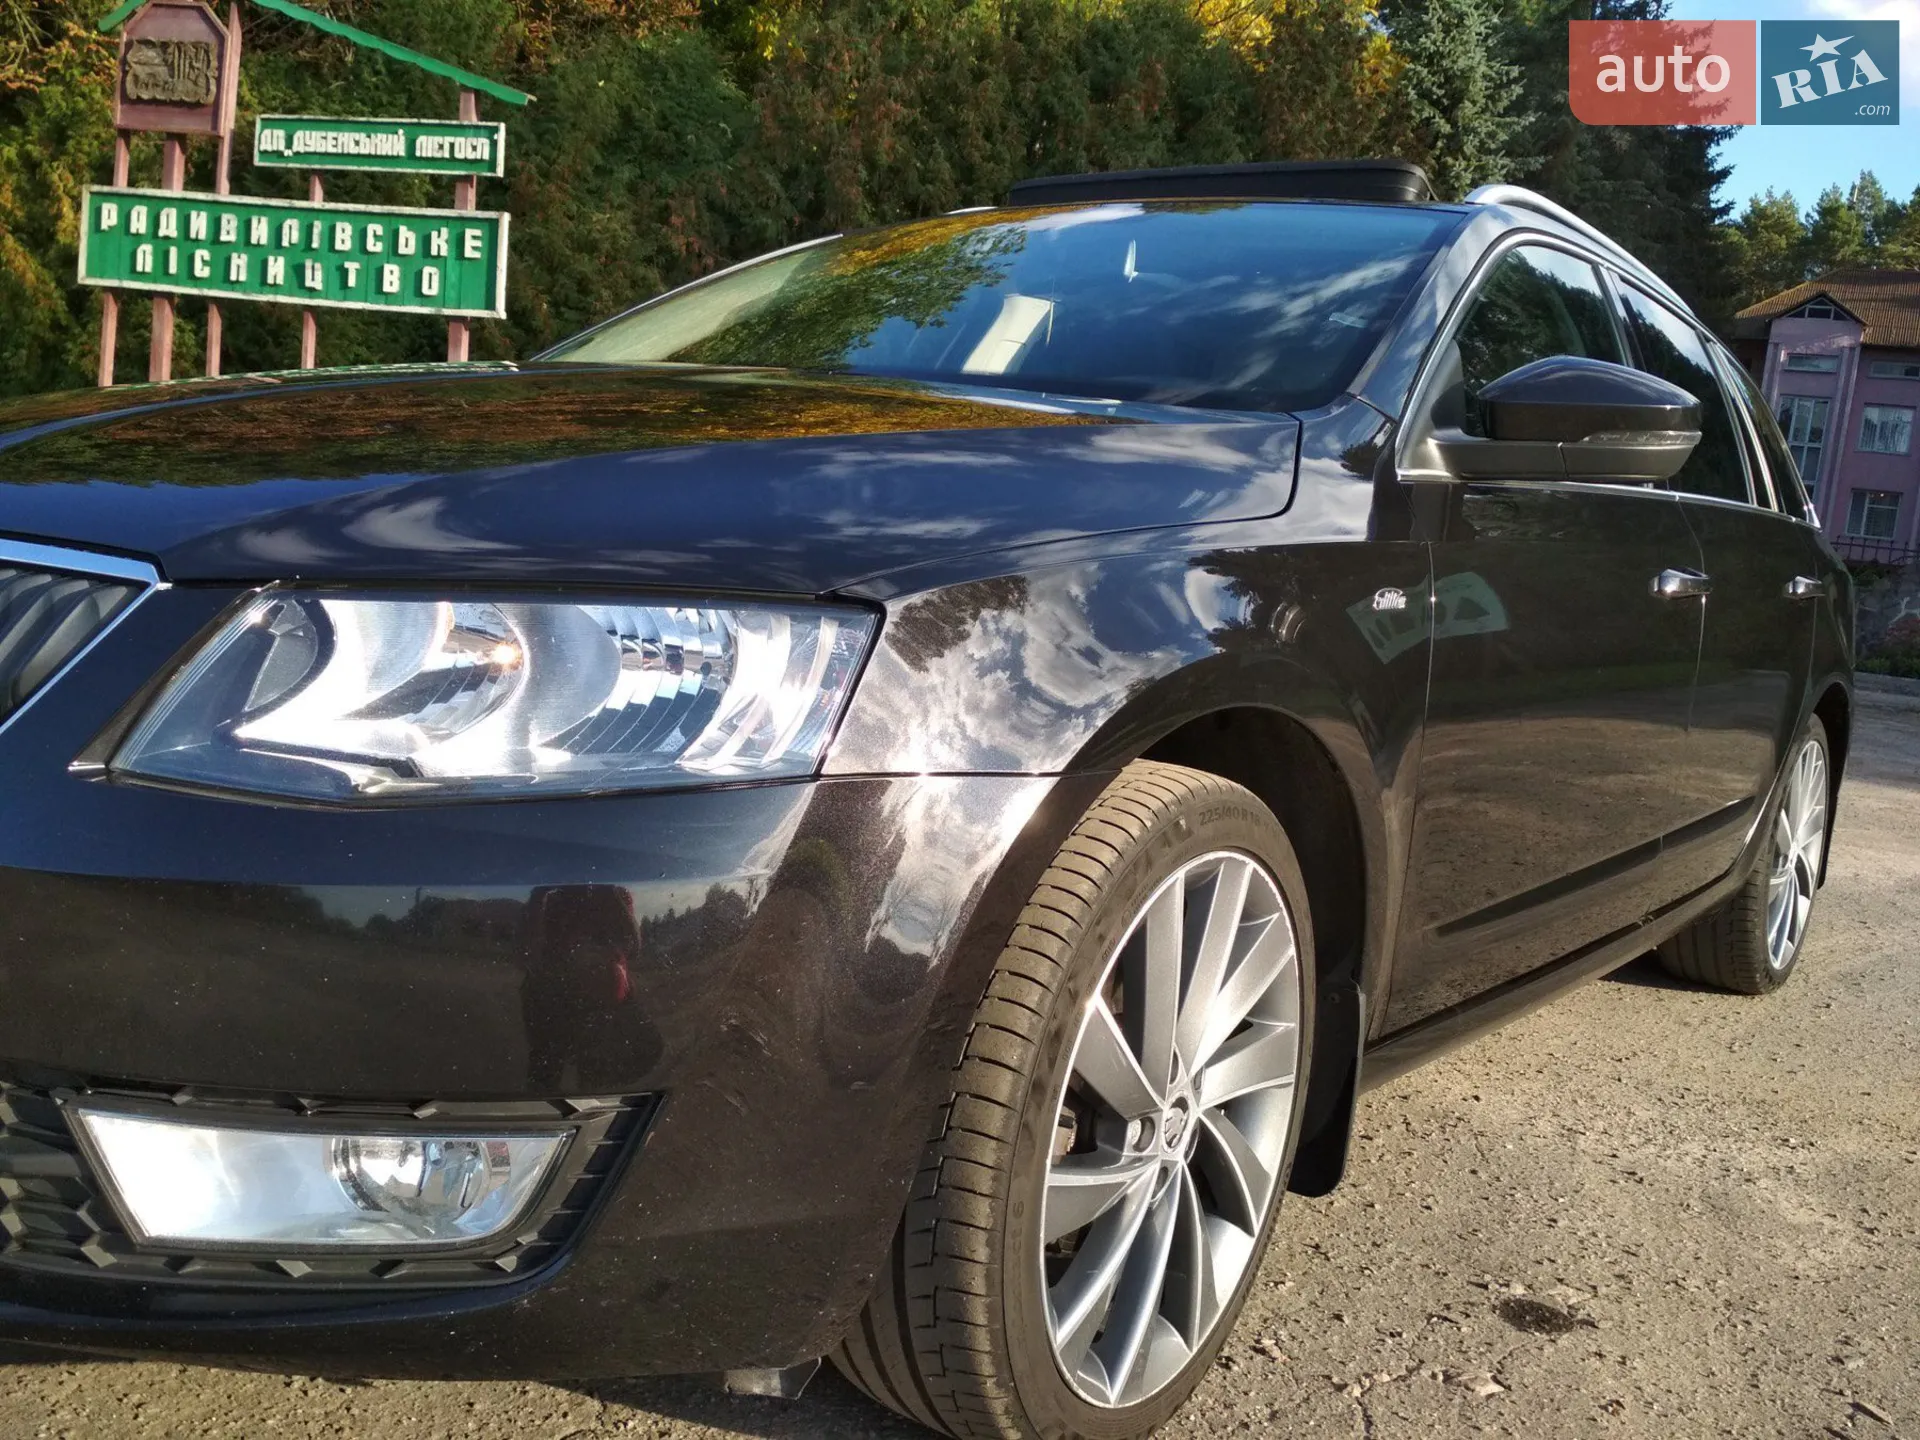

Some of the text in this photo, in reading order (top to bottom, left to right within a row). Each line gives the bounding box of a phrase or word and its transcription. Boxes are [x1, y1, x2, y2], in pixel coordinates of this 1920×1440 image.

[260, 129, 286, 152] ДП
[100, 203, 483, 259] РАДИВИЛІВСЬКЕ
[136, 244, 440, 297] ЛІСНИЦТВО
